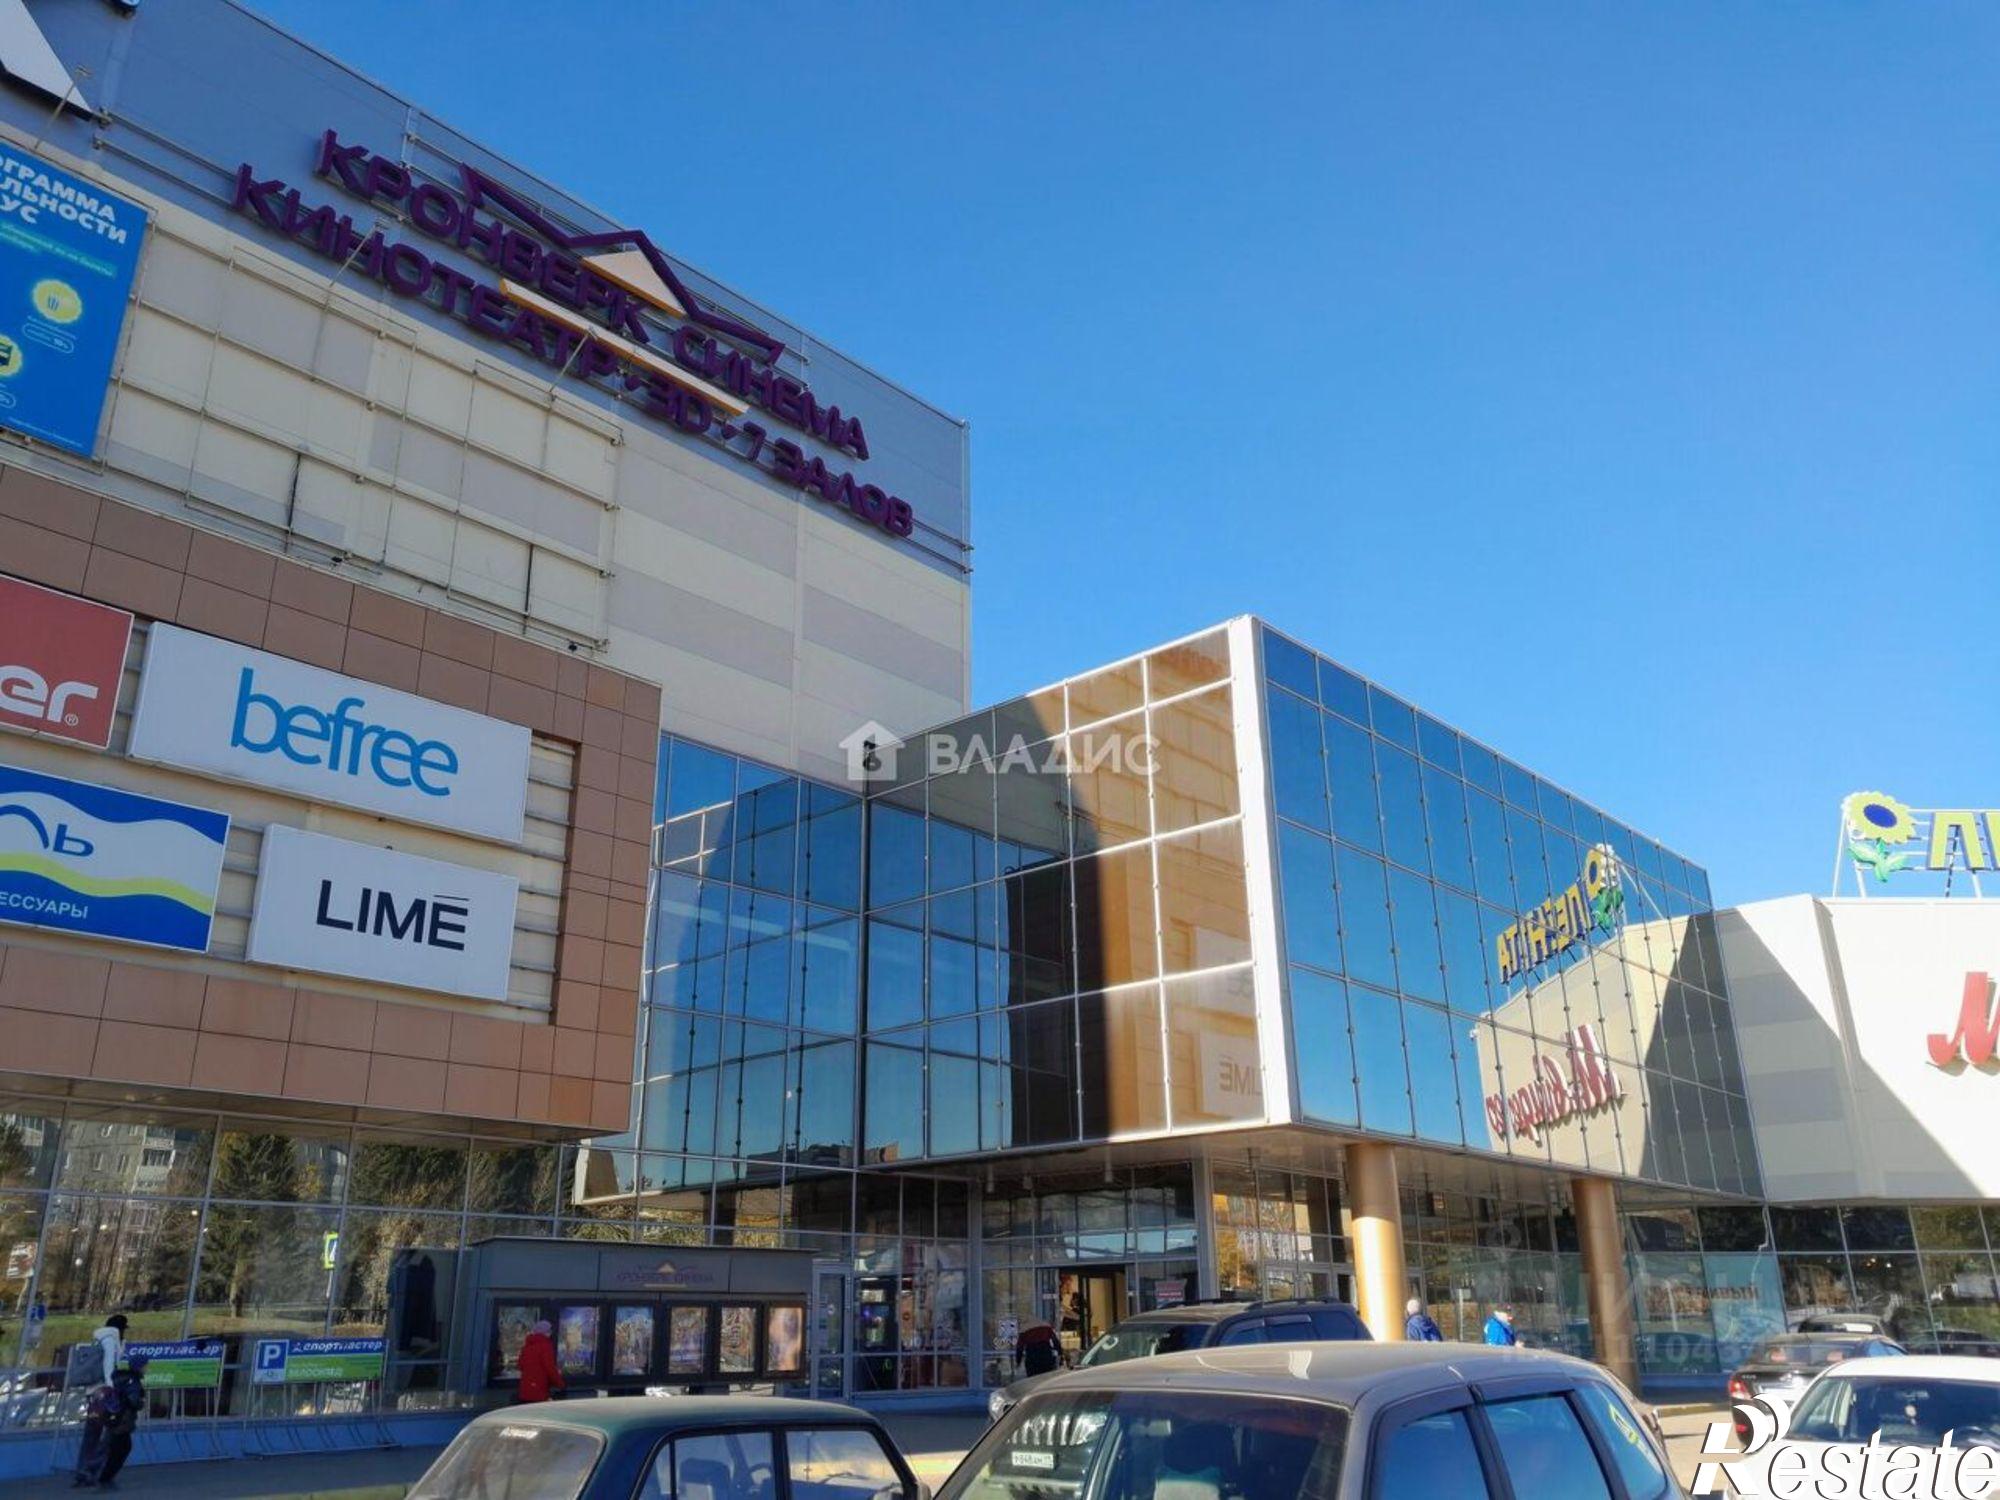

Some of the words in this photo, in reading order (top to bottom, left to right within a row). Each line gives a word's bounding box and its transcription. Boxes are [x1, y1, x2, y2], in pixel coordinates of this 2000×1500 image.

[0, 156, 116, 223] ГРАММА
[0, 172, 127, 244] ЛЬНОСТИ
[232, 163, 619, 379] КИНОТЕАТР
[743, 421, 767, 462] 7
[774, 437, 914, 539] ЗАЛОВ
[317, 128, 650, 344] КРОНВЕРК
[672, 325, 870, 461] СИНЕМА
[231, 667, 459, 797] befree
